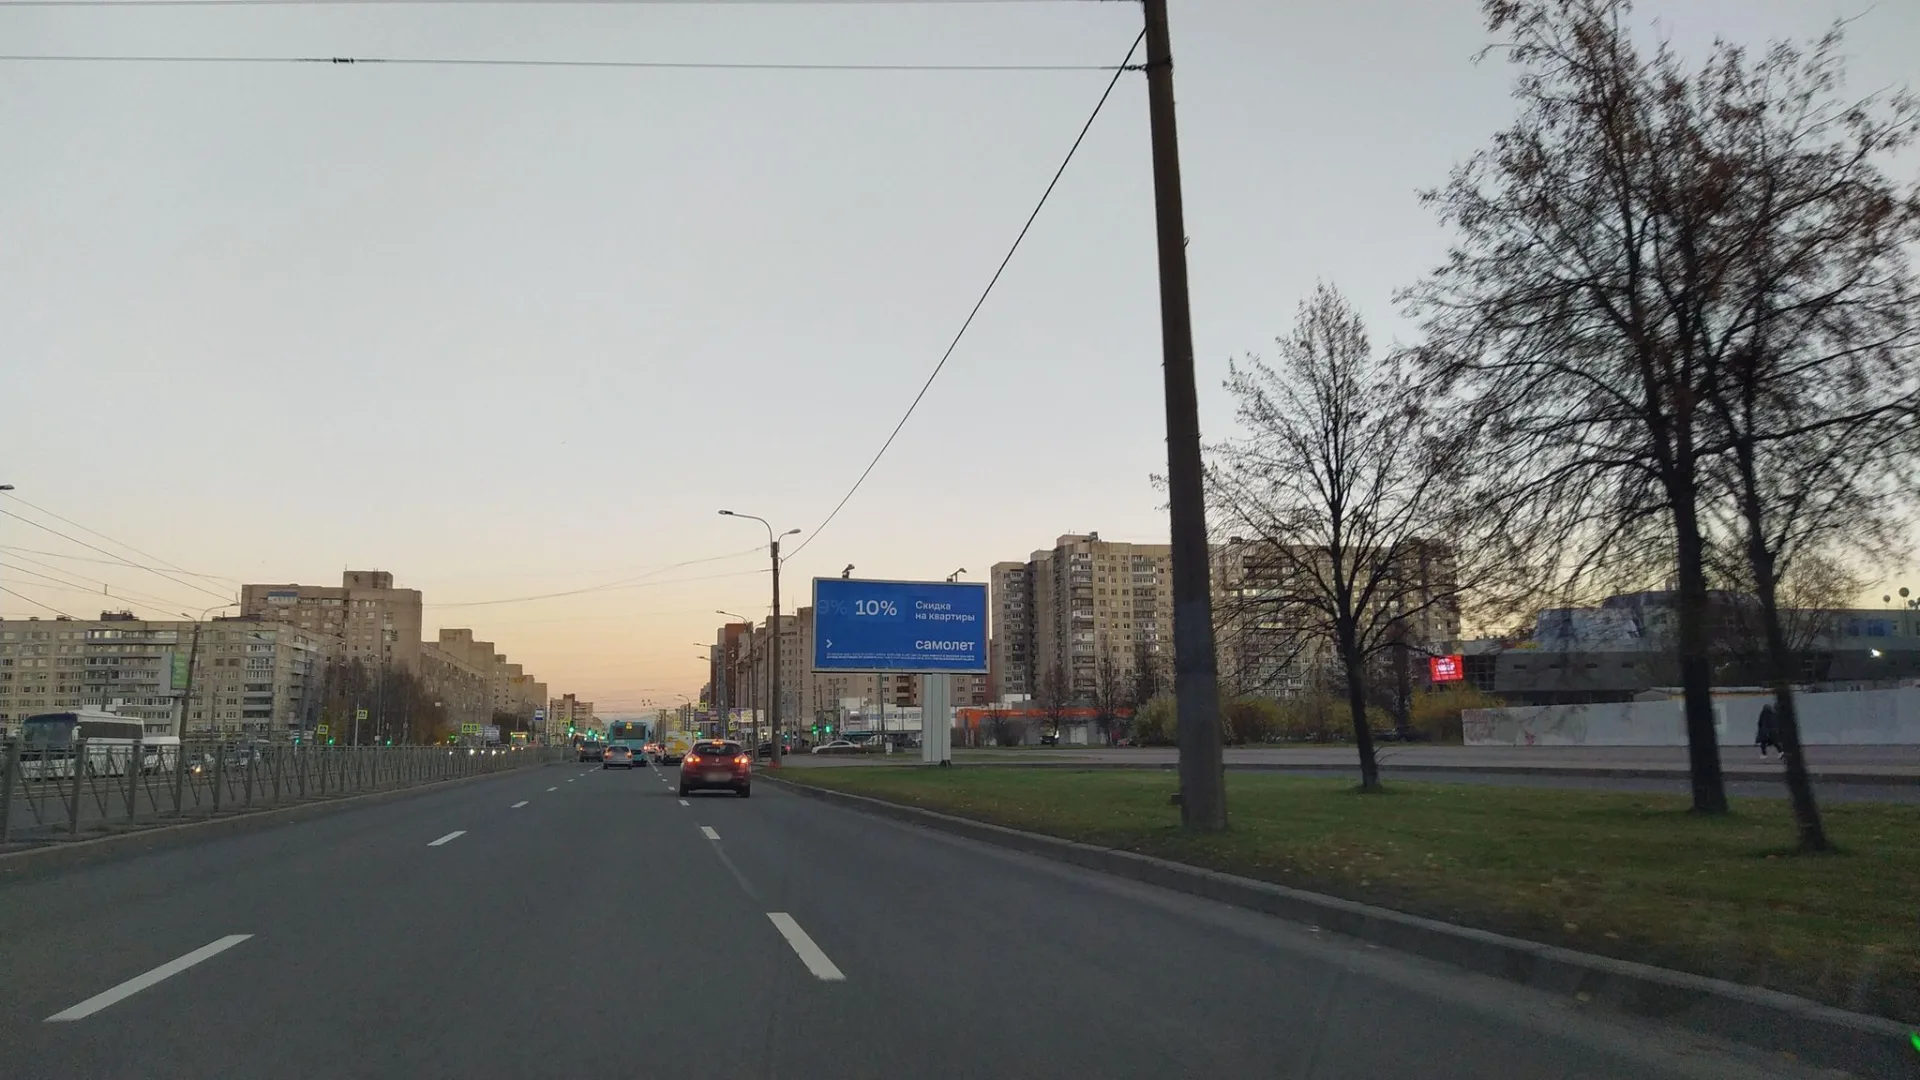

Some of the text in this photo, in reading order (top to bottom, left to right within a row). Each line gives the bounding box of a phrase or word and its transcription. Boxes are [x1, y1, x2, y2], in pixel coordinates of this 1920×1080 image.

[855, 599, 898, 616] 10%
[915, 600, 951, 611] Скидка
[928, 613, 975, 622] квартиры
[915, 639, 975, 651] самолет
